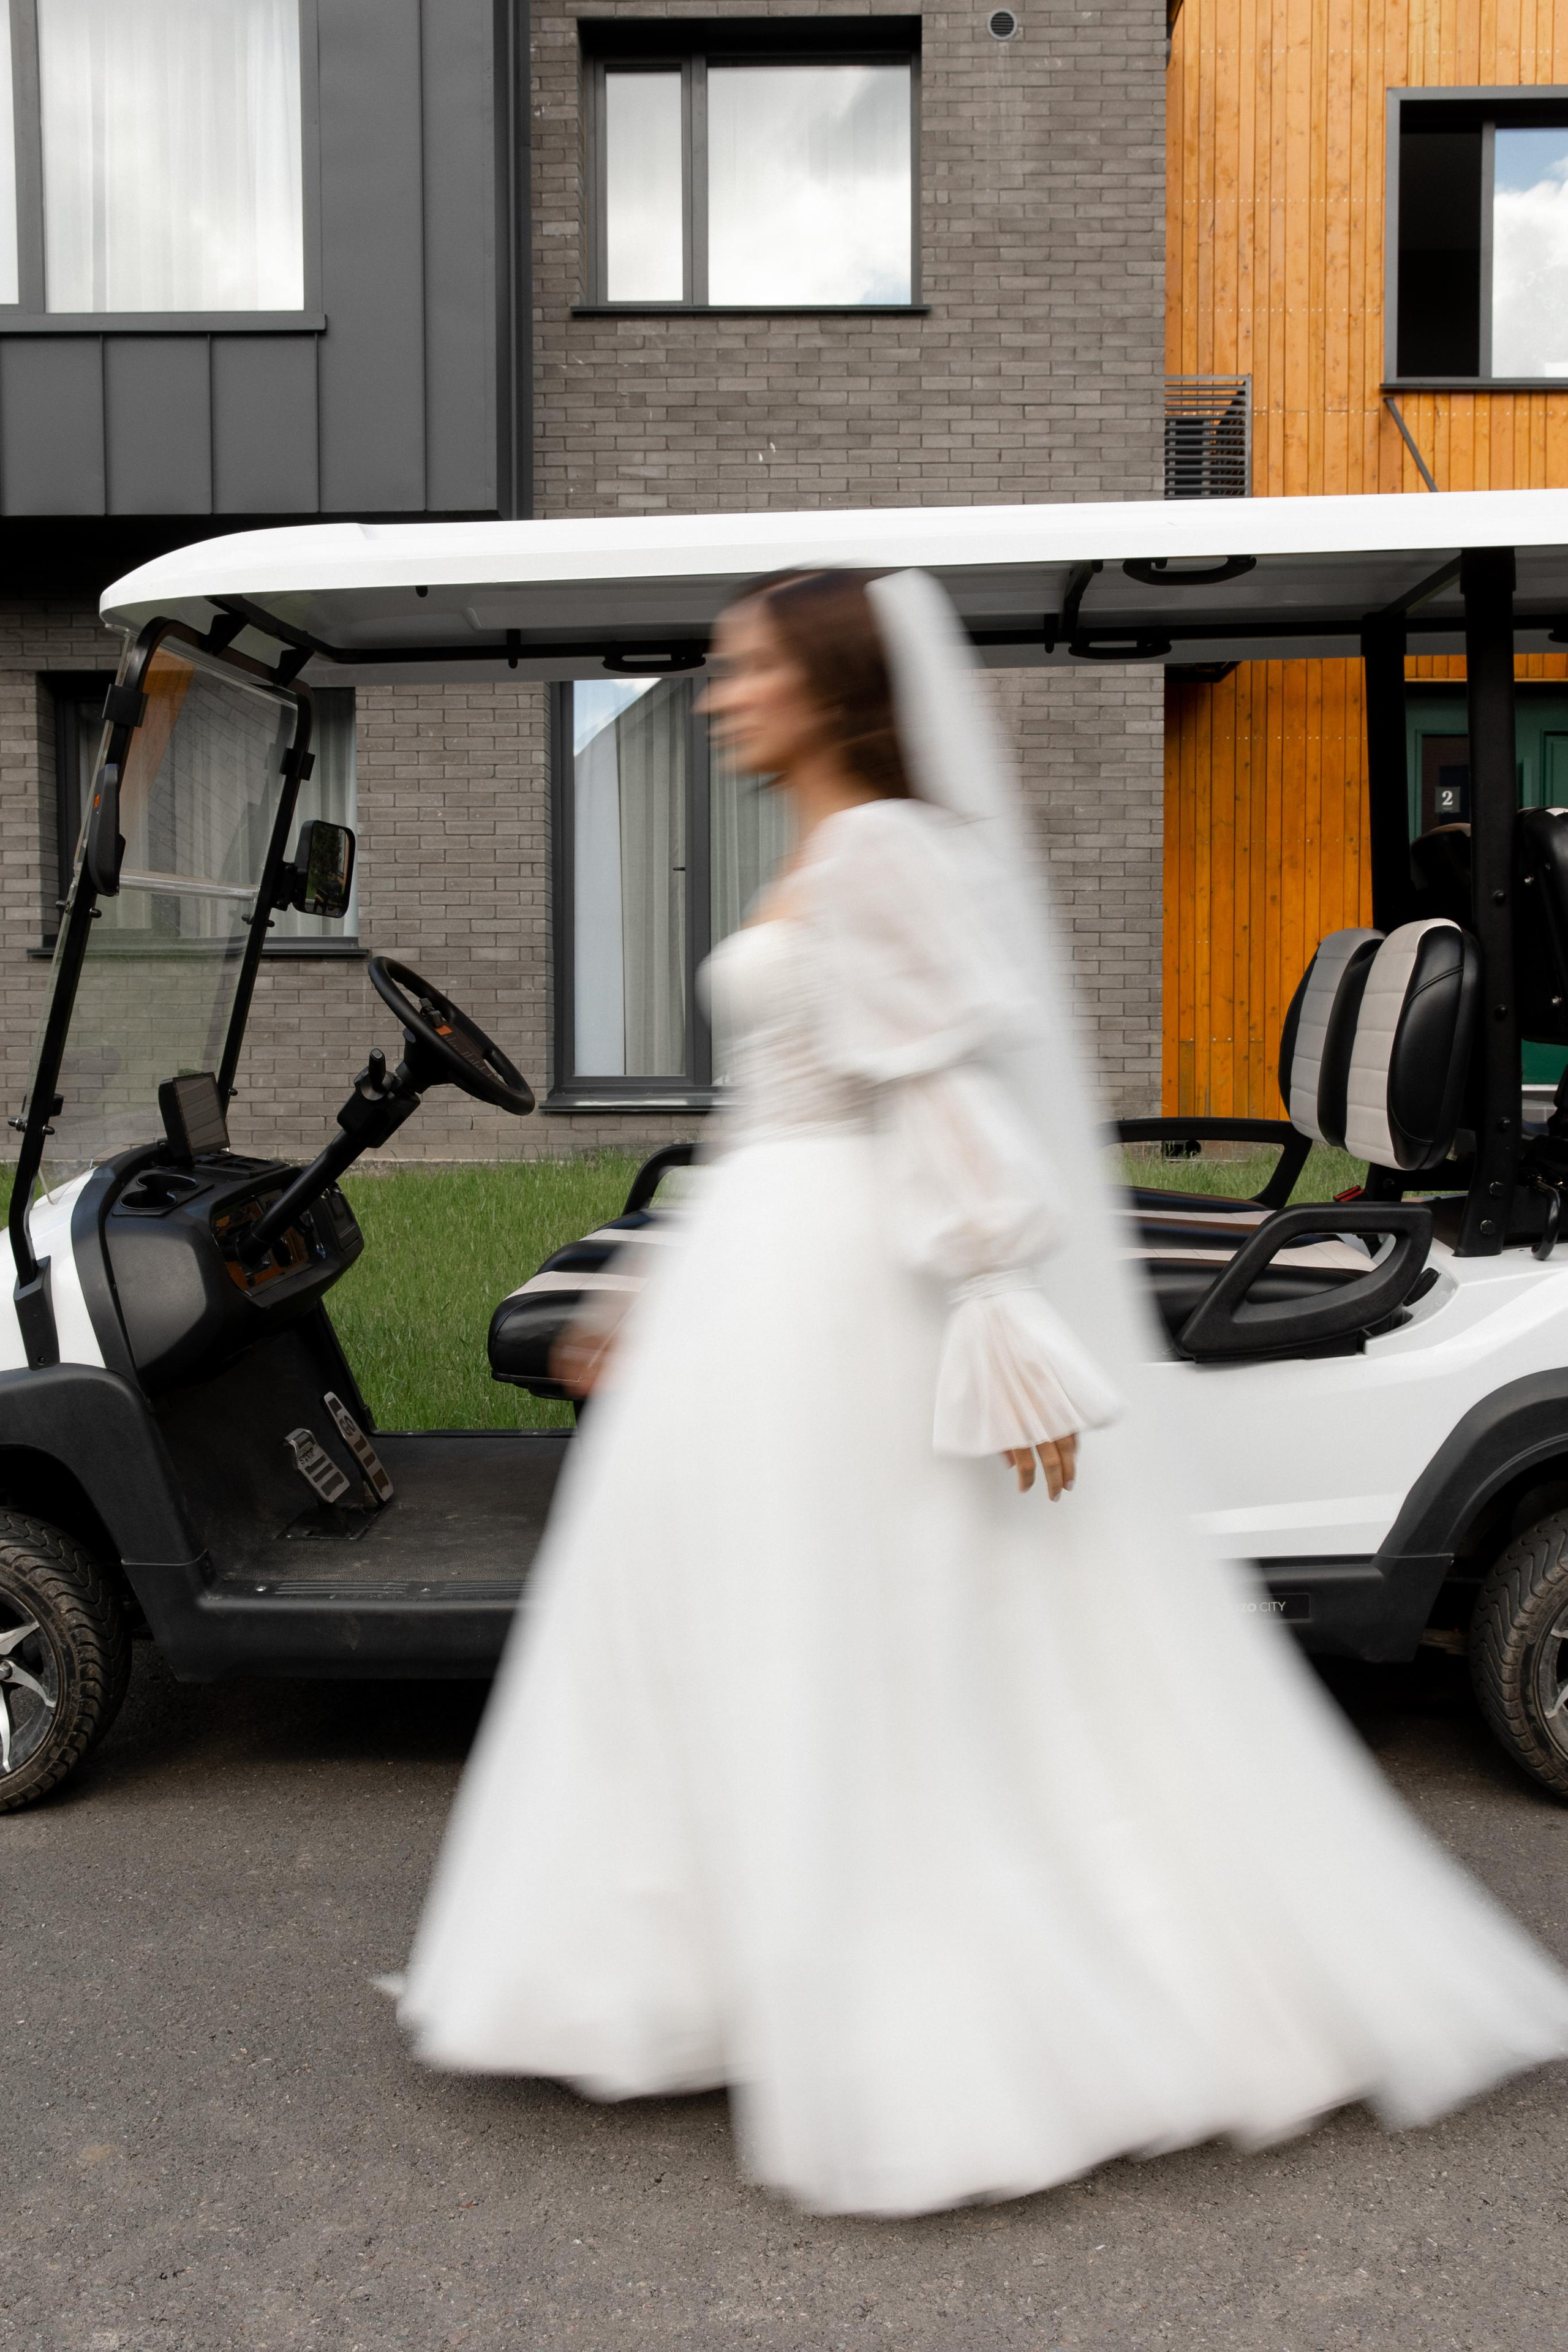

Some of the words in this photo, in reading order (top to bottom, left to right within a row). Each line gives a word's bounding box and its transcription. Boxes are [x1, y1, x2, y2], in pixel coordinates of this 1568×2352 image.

[1442, 790, 1453, 805] 2
[339, 1415, 356, 1436] GO
[1259, 1601, 1286, 1612] CITY
